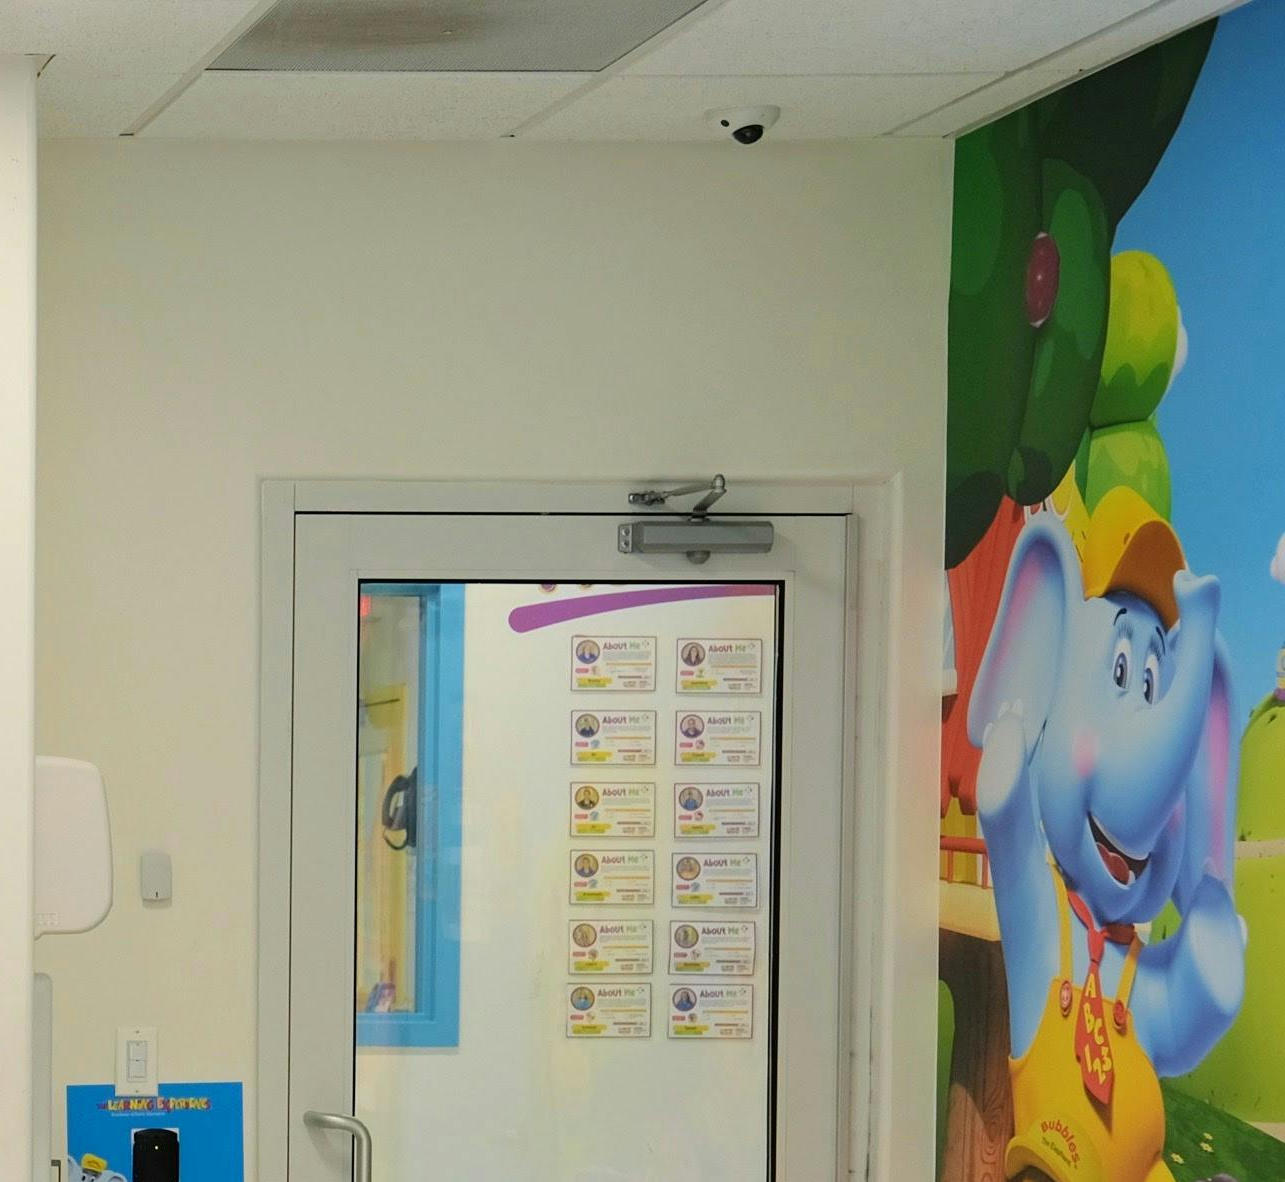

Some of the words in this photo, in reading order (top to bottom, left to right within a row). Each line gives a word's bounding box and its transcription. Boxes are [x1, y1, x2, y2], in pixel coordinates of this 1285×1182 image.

[108, 1099, 155, 1112] LEARNING
[156, 1097, 212, 1112] EXPERIENCE
[1040, 1119, 1079, 1163] Bubbles
